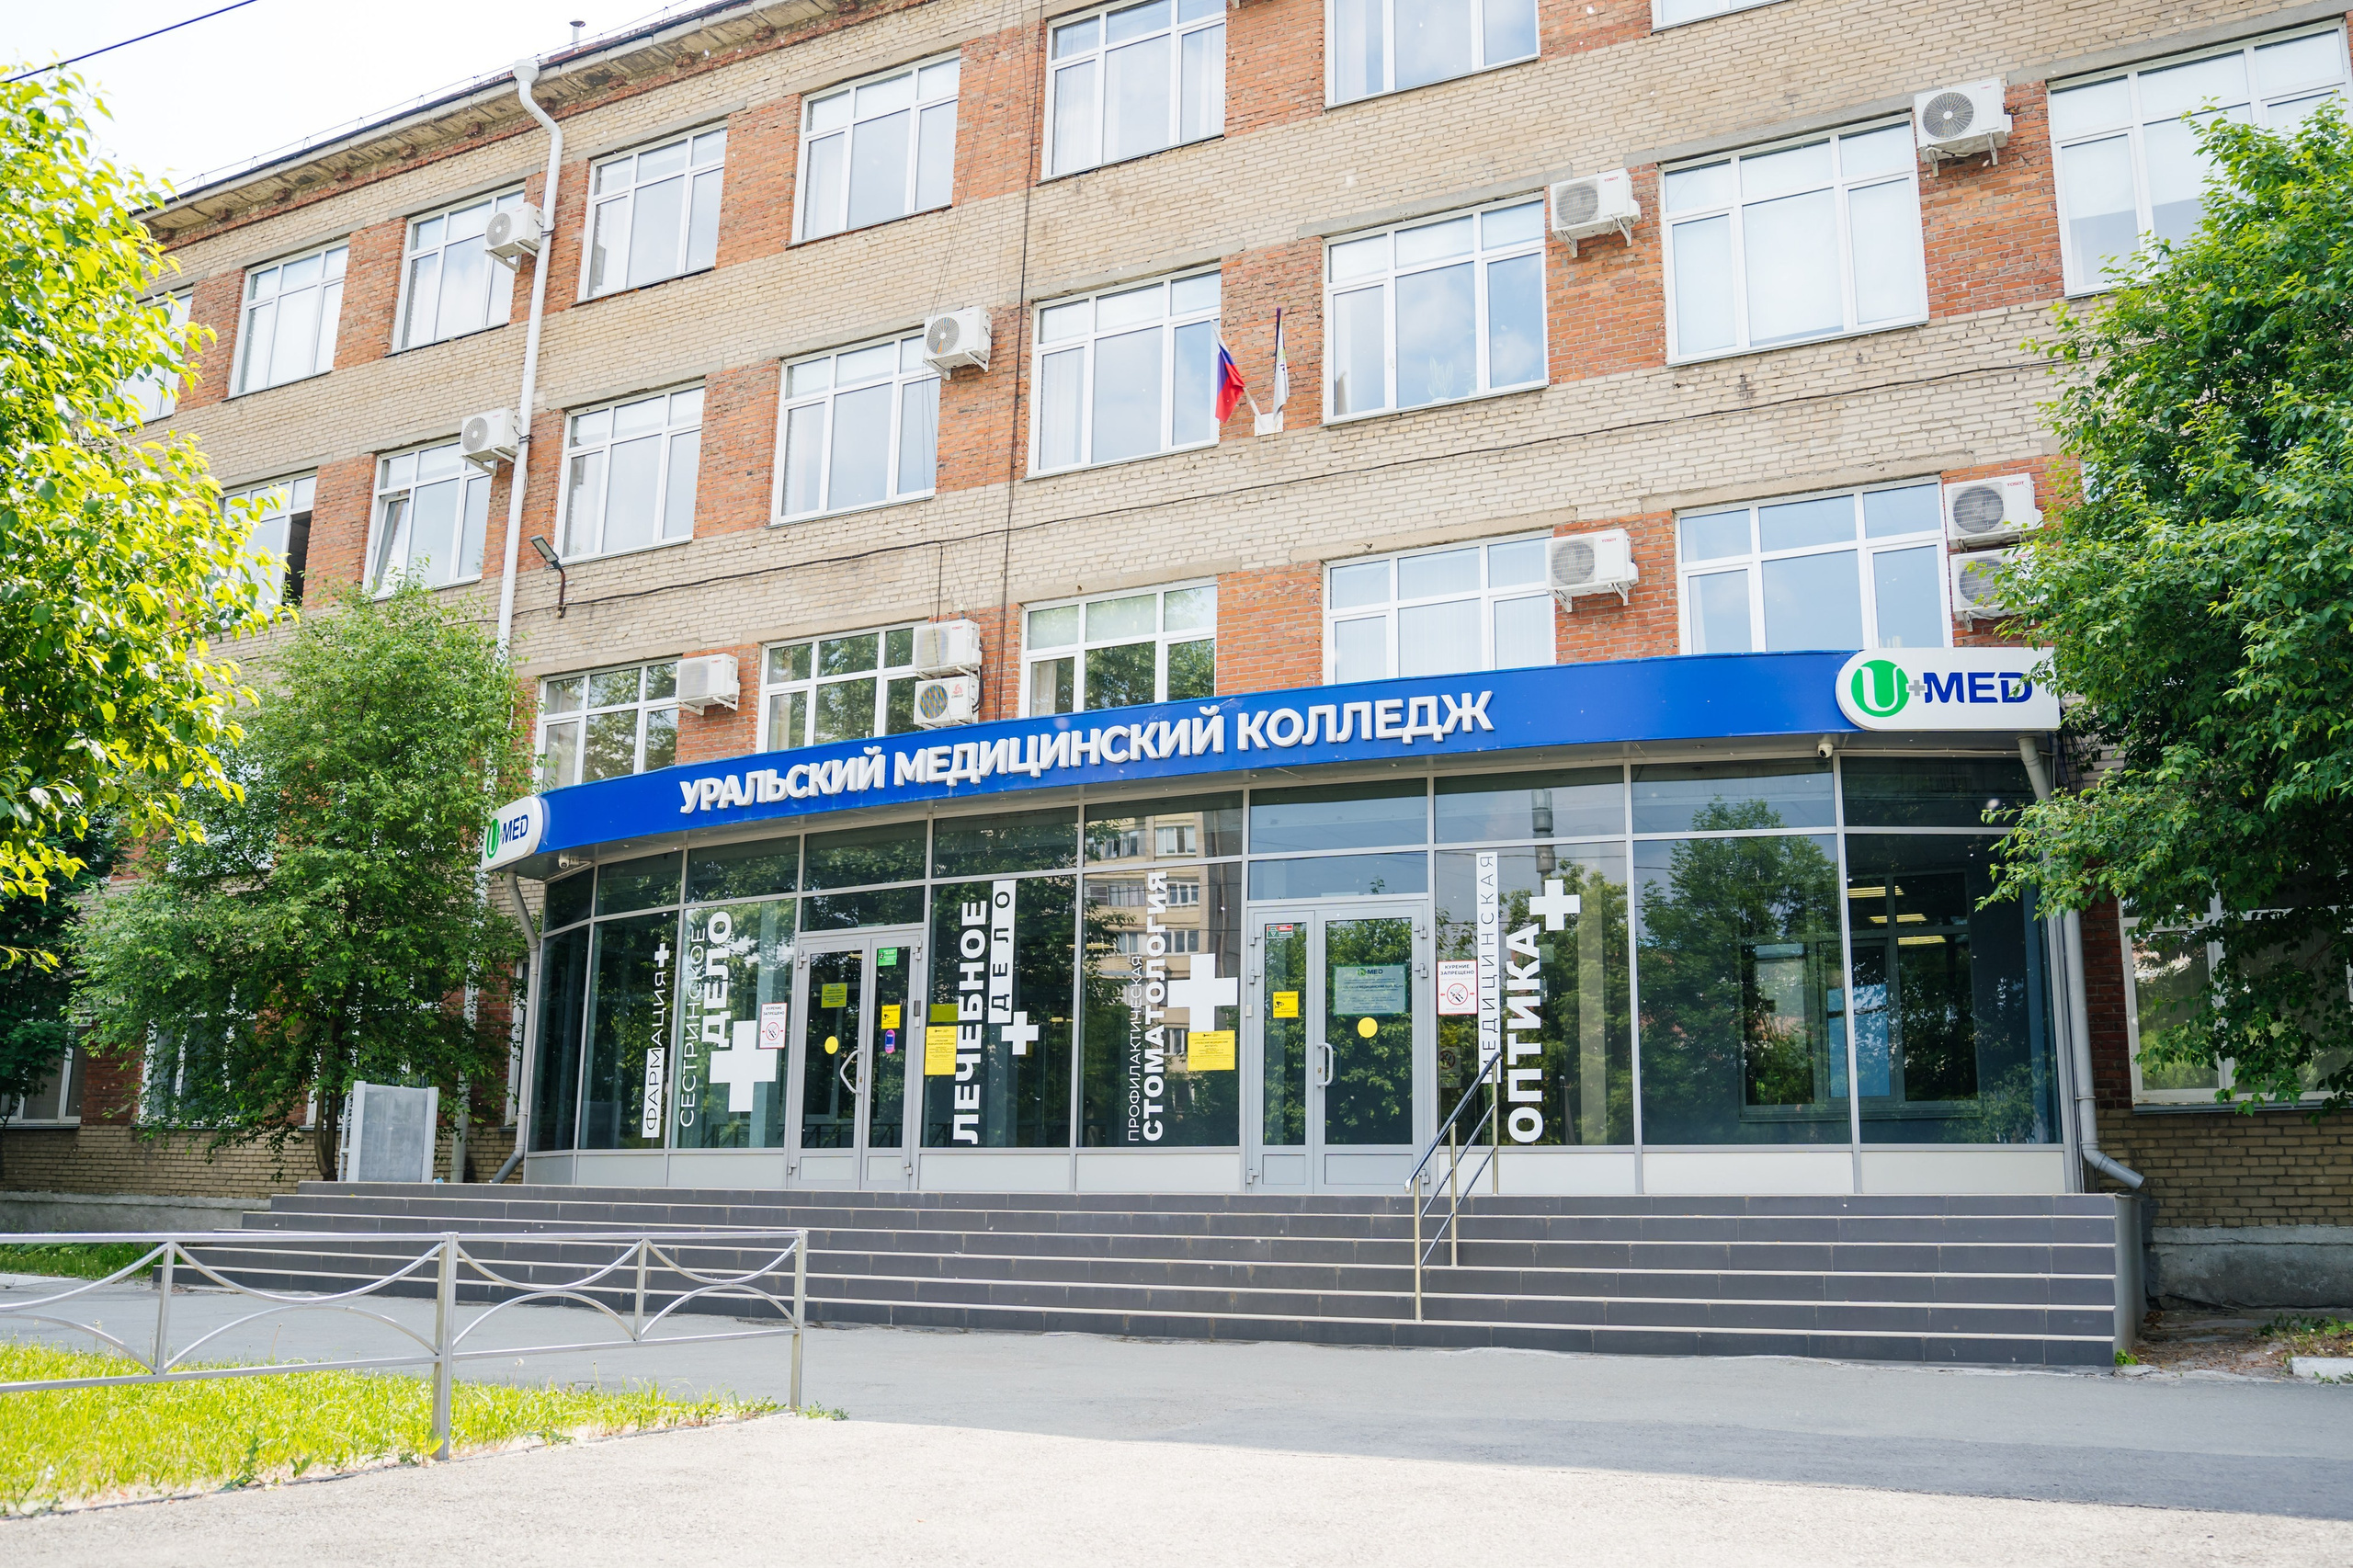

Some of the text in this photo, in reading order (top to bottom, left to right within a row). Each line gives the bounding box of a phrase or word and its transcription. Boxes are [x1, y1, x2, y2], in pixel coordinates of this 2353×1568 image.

[679, 690, 1495, 813] УРАЛЬСКИЙ МЕДИЦИНСКИЙ КОЛЛЕДЖ
[679, 927, 706, 1128] СЕСТРИНСКОЕ
[701, 912, 733, 1048] ДЕЛО
[952, 900, 987, 1144] ЛЕЧЕБНОЕ
[991, 891, 1011, 1012] ДЕЛО
[1142, 871, 1167, 1142] СТОМАТОЛОГИЯ
[1506, 923, 1543, 1143] ОПТИКА
[645, 971, 667, 1131] ФАРМАЦИЯ
[1128, 956, 1142, 1142] ПРОФИЛАКТИЧЕСКАЯ
